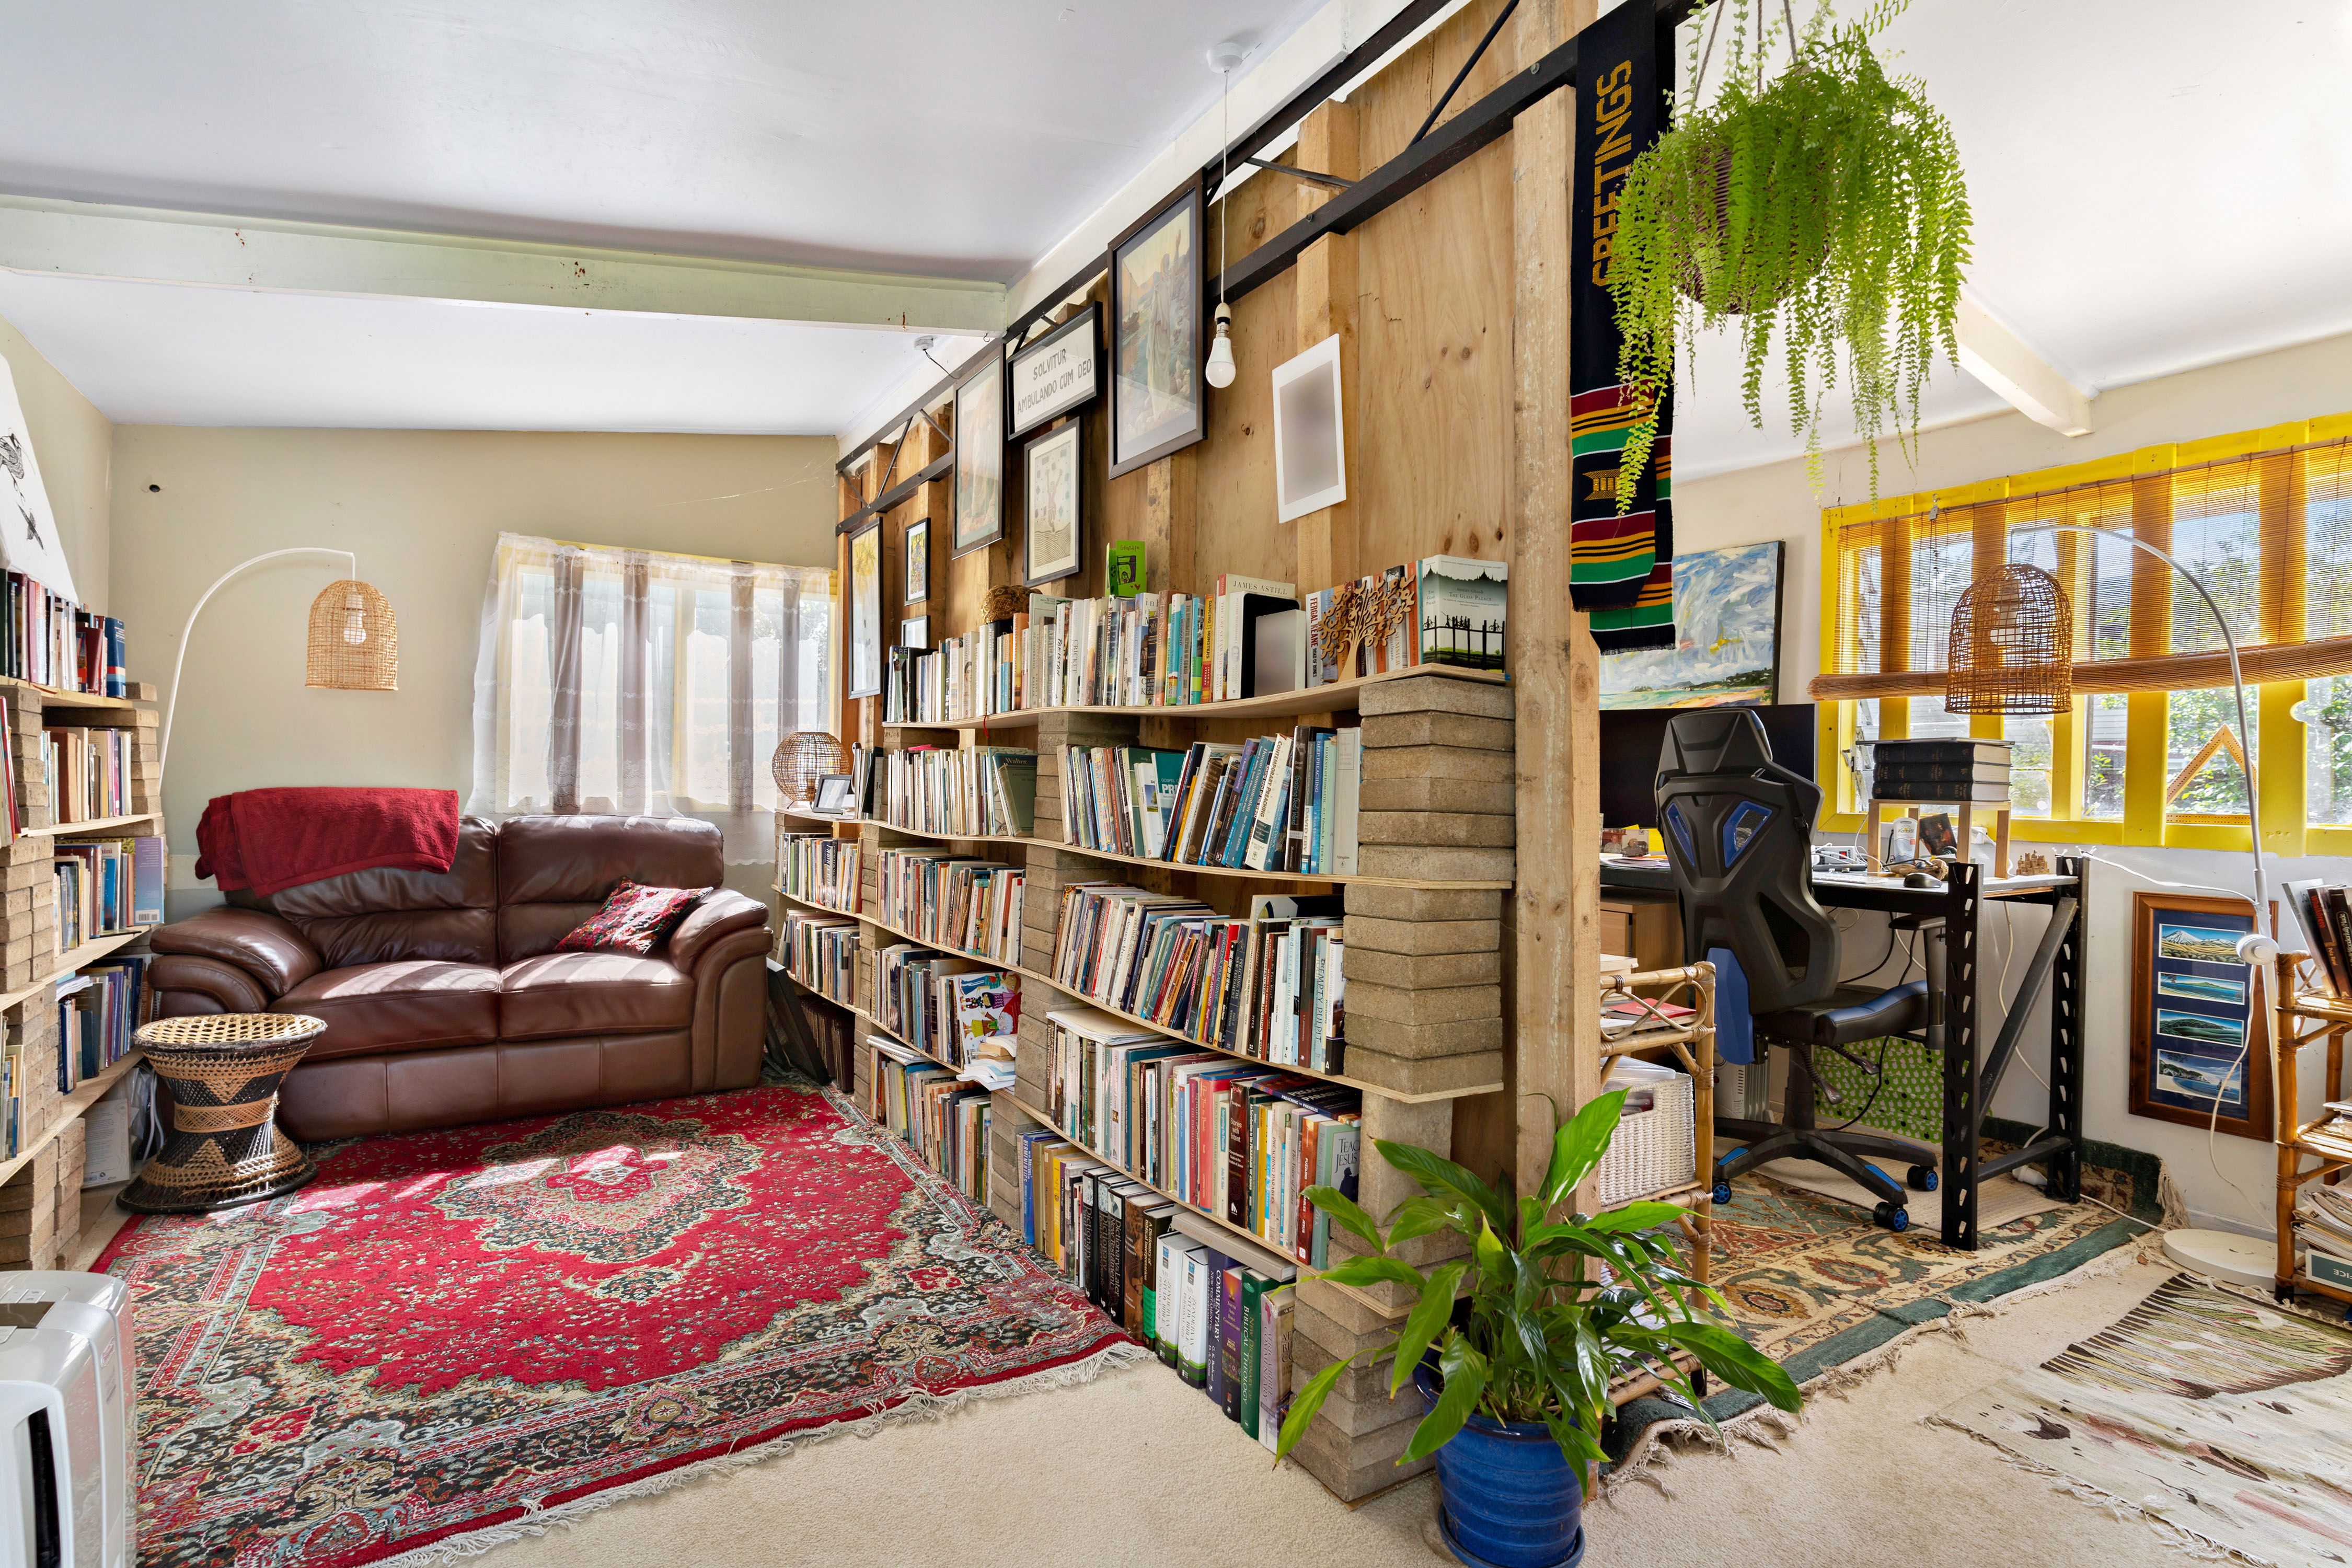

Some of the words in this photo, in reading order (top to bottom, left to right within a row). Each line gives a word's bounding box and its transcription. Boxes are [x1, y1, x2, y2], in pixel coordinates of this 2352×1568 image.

[1033, 349, 1066, 381] SOLVITUR
[1018, 380, 1057, 414] AMBULANDO
[1060, 369, 1074, 389] CUM
[1078, 359, 1091, 379] DEO
[1233, 580, 1258, 590] JAMES
[1260, 585, 1288, 595] ASTILL
[1258, 748, 1267, 768] Human
[1268, 741, 1283, 787] CONTEMPORARY
[1246, 769, 1262, 813] Communication
[1291, 776, 1301, 797] Grasping
[1260, 787, 1272, 818] PREACHING
[1291, 811, 1299, 825] Word
[1238, 824, 1247, 838] Zealand
[1215, 966, 1223, 999] PREACHING
[1313, 1007, 1323, 1043] PULPIT
[1281, 1095, 1299, 1105] PREACHING
[1302, 1103, 1318, 1112] PARABLES
[1230, 1117, 1242, 1128] Stories
[1231, 1133, 1241, 1143] Intent
[1335, 1153, 1358, 1173] JESUS
[1227, 1301, 1237, 1309] South
[1223, 1316, 1241, 1332] Commentary
[1248, 1390, 1253, 1400] OF
